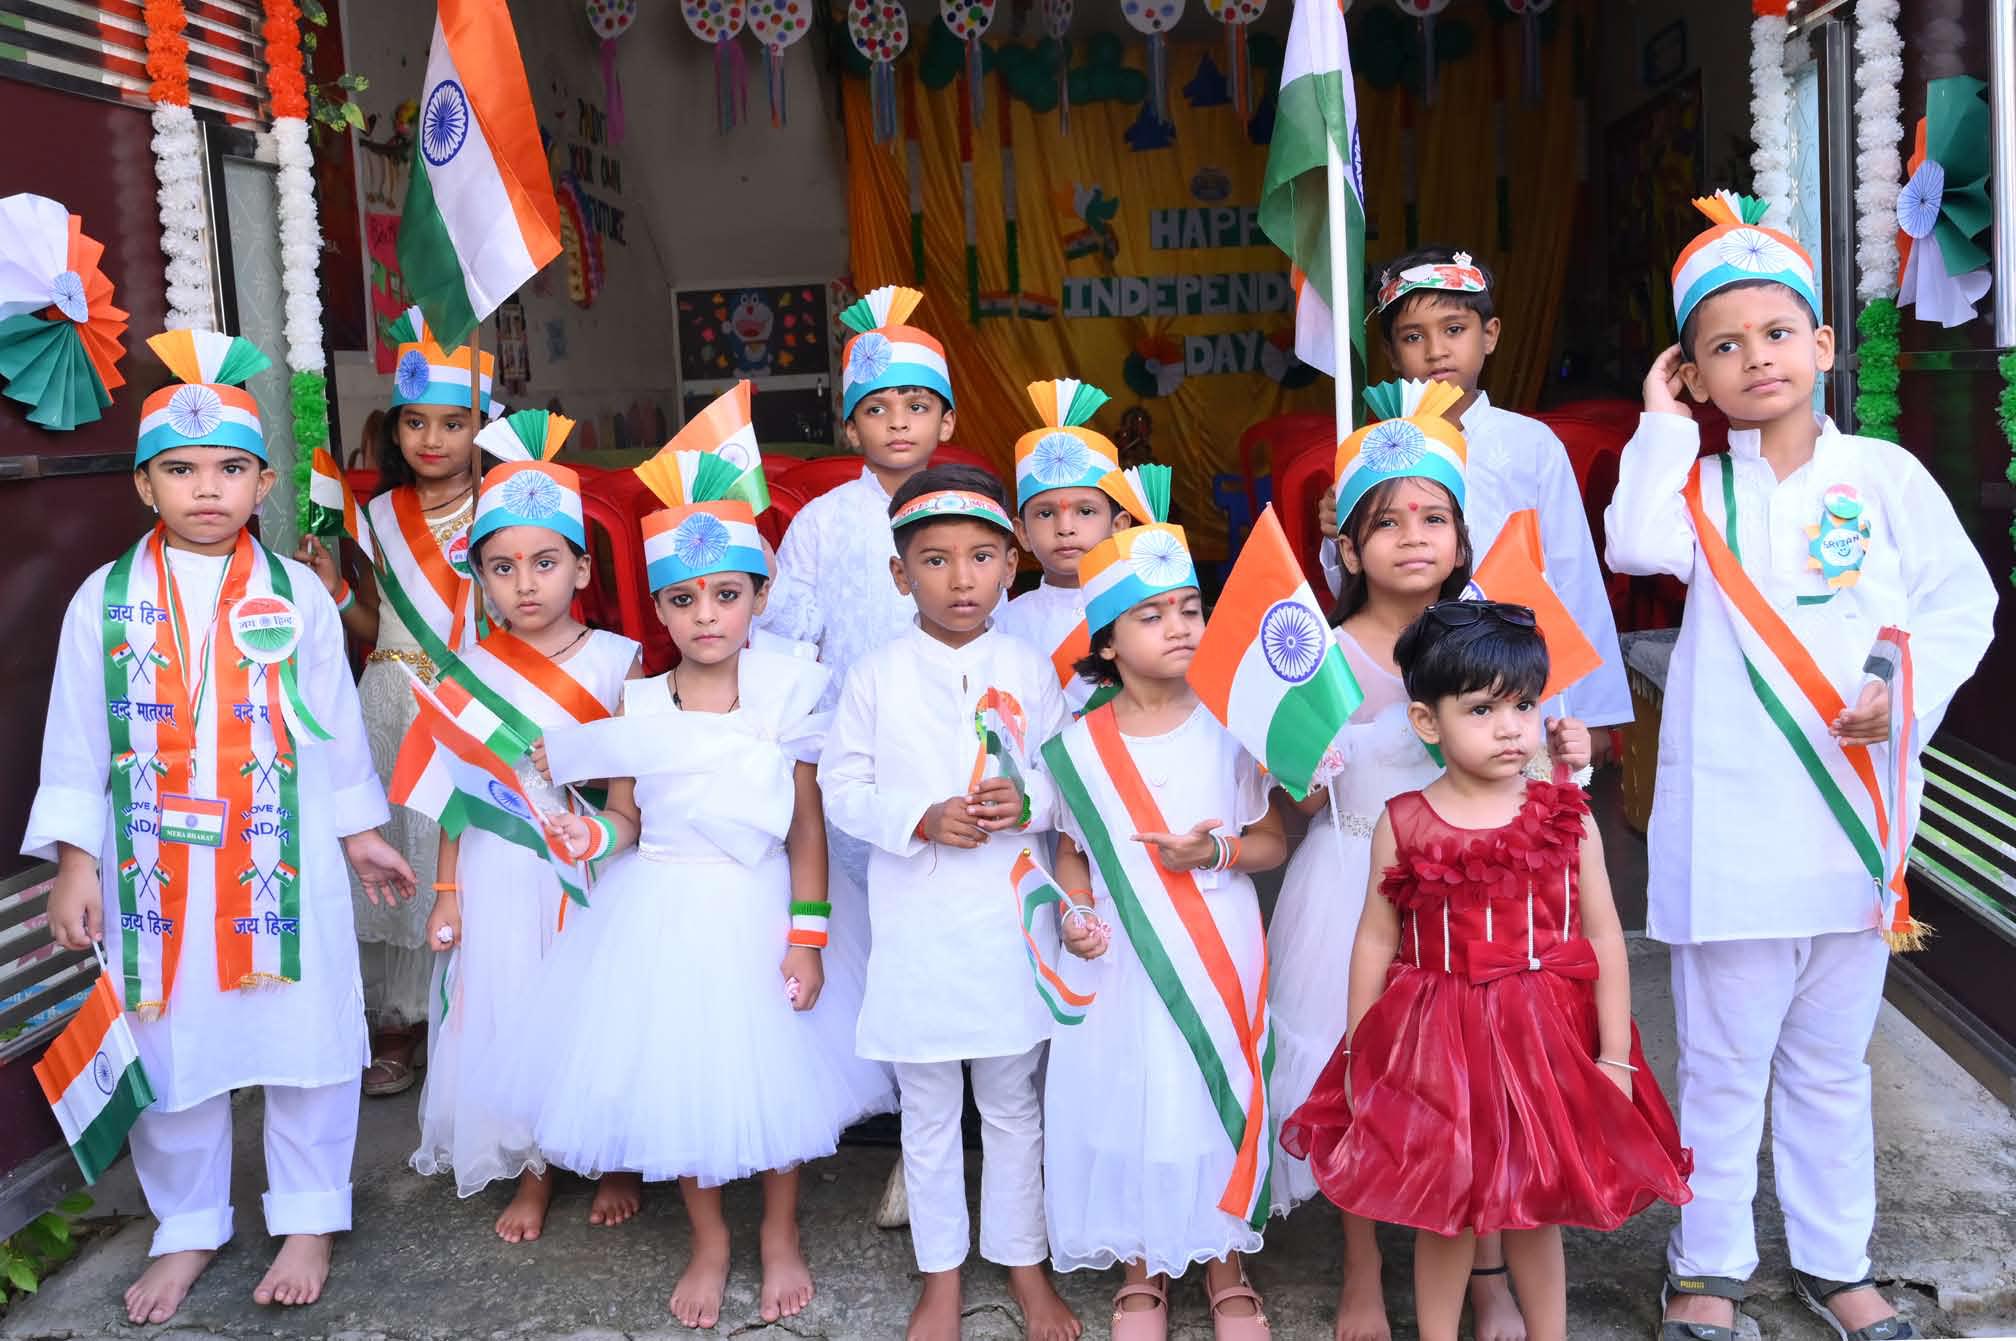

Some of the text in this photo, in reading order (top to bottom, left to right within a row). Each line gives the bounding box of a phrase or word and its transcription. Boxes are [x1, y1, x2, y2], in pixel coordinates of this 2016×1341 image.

[1152, 208, 1259, 248] HAPP
[1064, 272, 1296, 317] INDEPEND
[1185, 331, 1262, 375] DAY
[107, 604, 134, 622] जय
[135, 702, 177, 727] मातरम्
[166, 829, 215, 841] MERA BHARAT
[240, 822, 290, 845] INDIA
[121, 910, 174, 936] जय हिन्द
[233, 911, 299, 935] जय हिन्द
